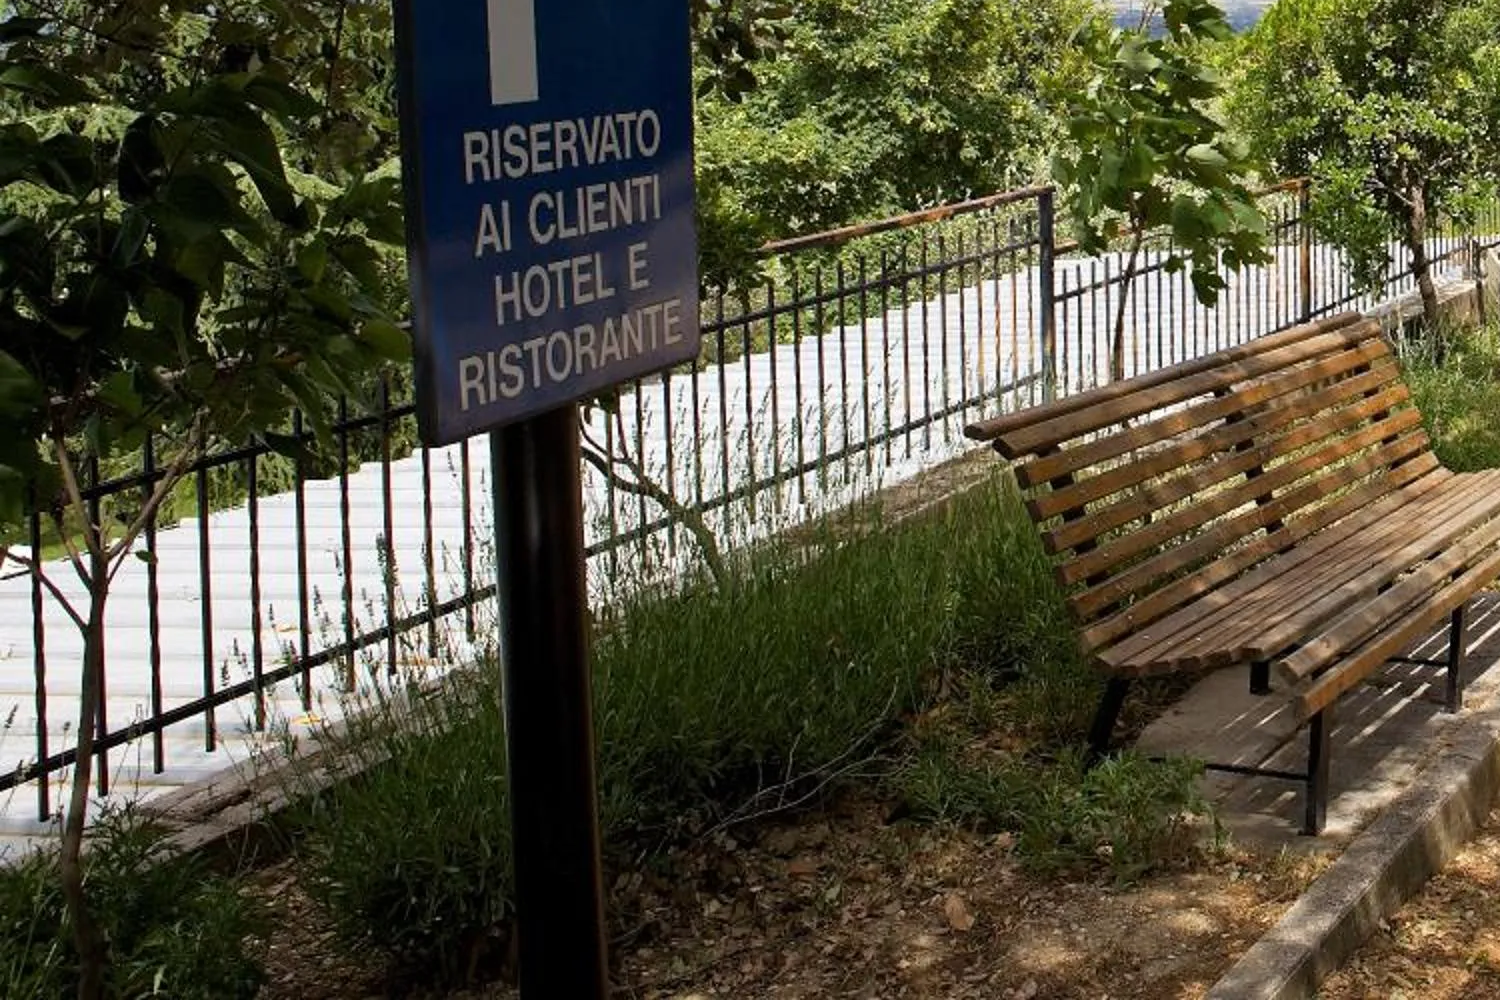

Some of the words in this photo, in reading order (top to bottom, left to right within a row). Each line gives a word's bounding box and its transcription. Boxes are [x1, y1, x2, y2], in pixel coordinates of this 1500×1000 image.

[464, 109, 661, 184] RISERVATO
[475, 200, 511, 257] AI
[528, 175, 661, 245] CLIENTI
[495, 255, 615, 326] HOTEL
[629, 242, 649, 291] E
[459, 299, 683, 411] RISTORANTE
